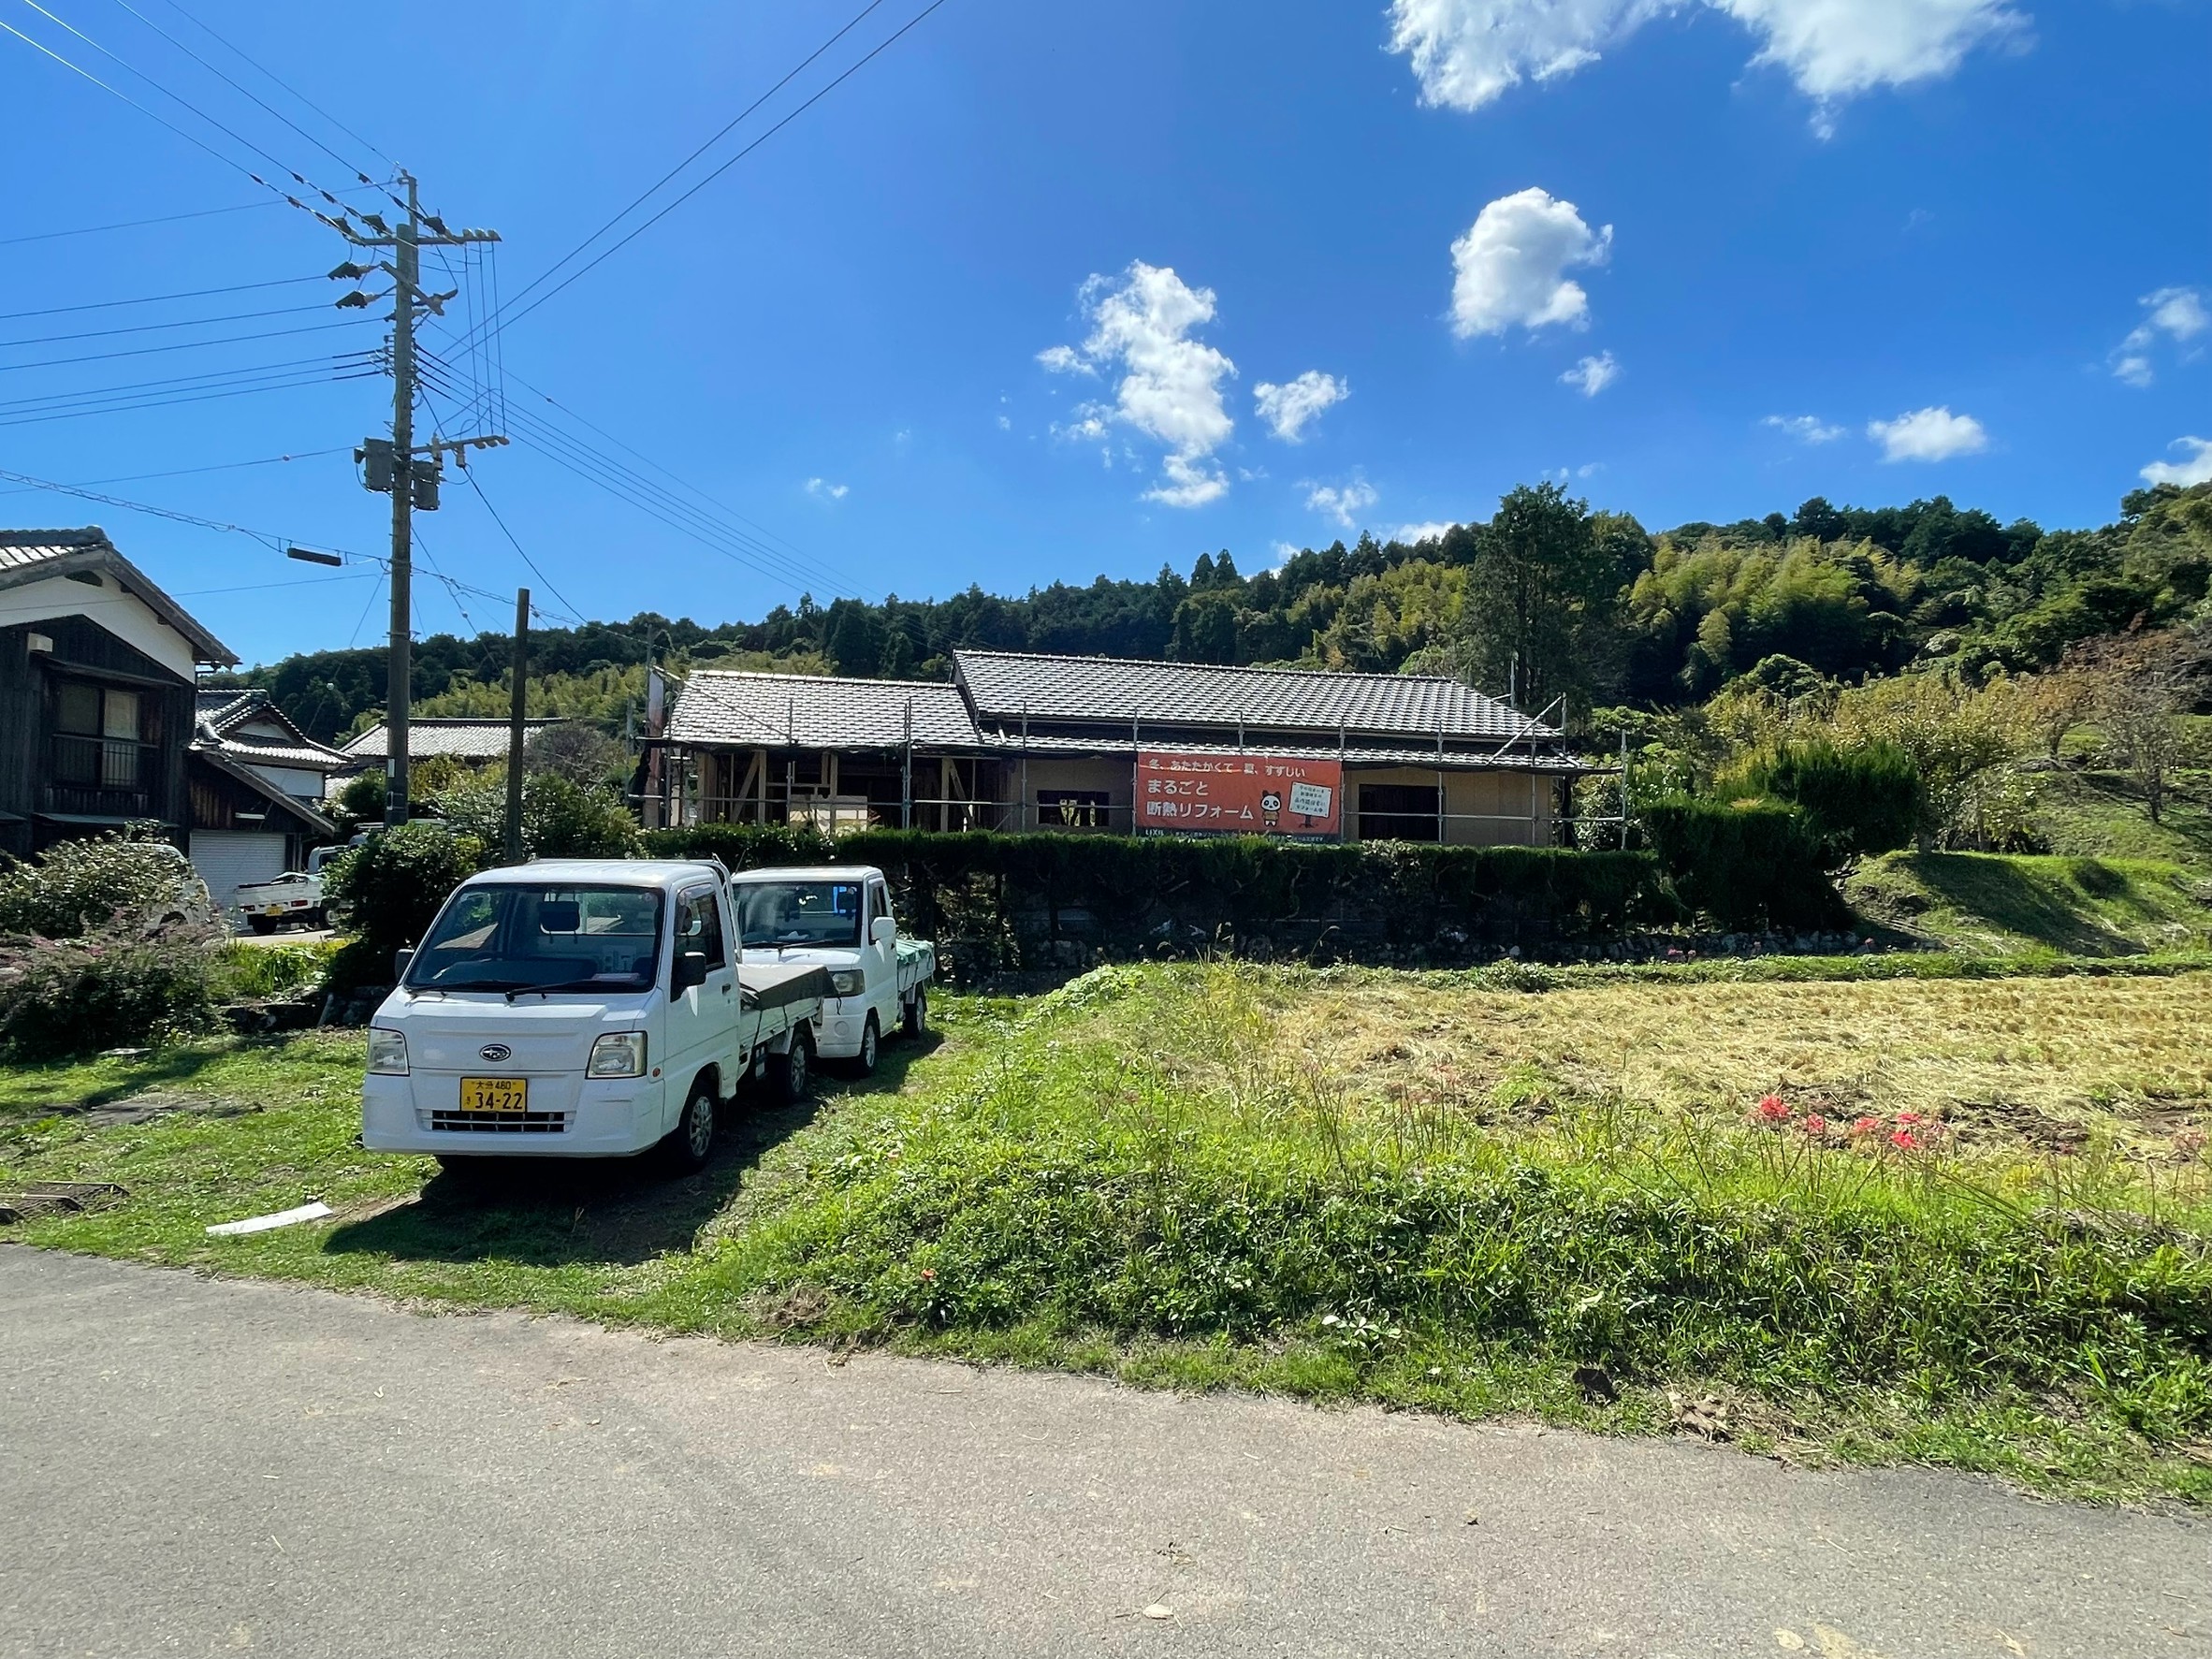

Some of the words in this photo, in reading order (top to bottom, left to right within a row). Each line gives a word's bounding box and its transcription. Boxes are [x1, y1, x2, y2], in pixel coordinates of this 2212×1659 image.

[1147, 779, 1209, 796] まるごと
[1146, 801, 1254, 821] 断熱リフォーム
[474, 1092, 523, 1110] 34-22
